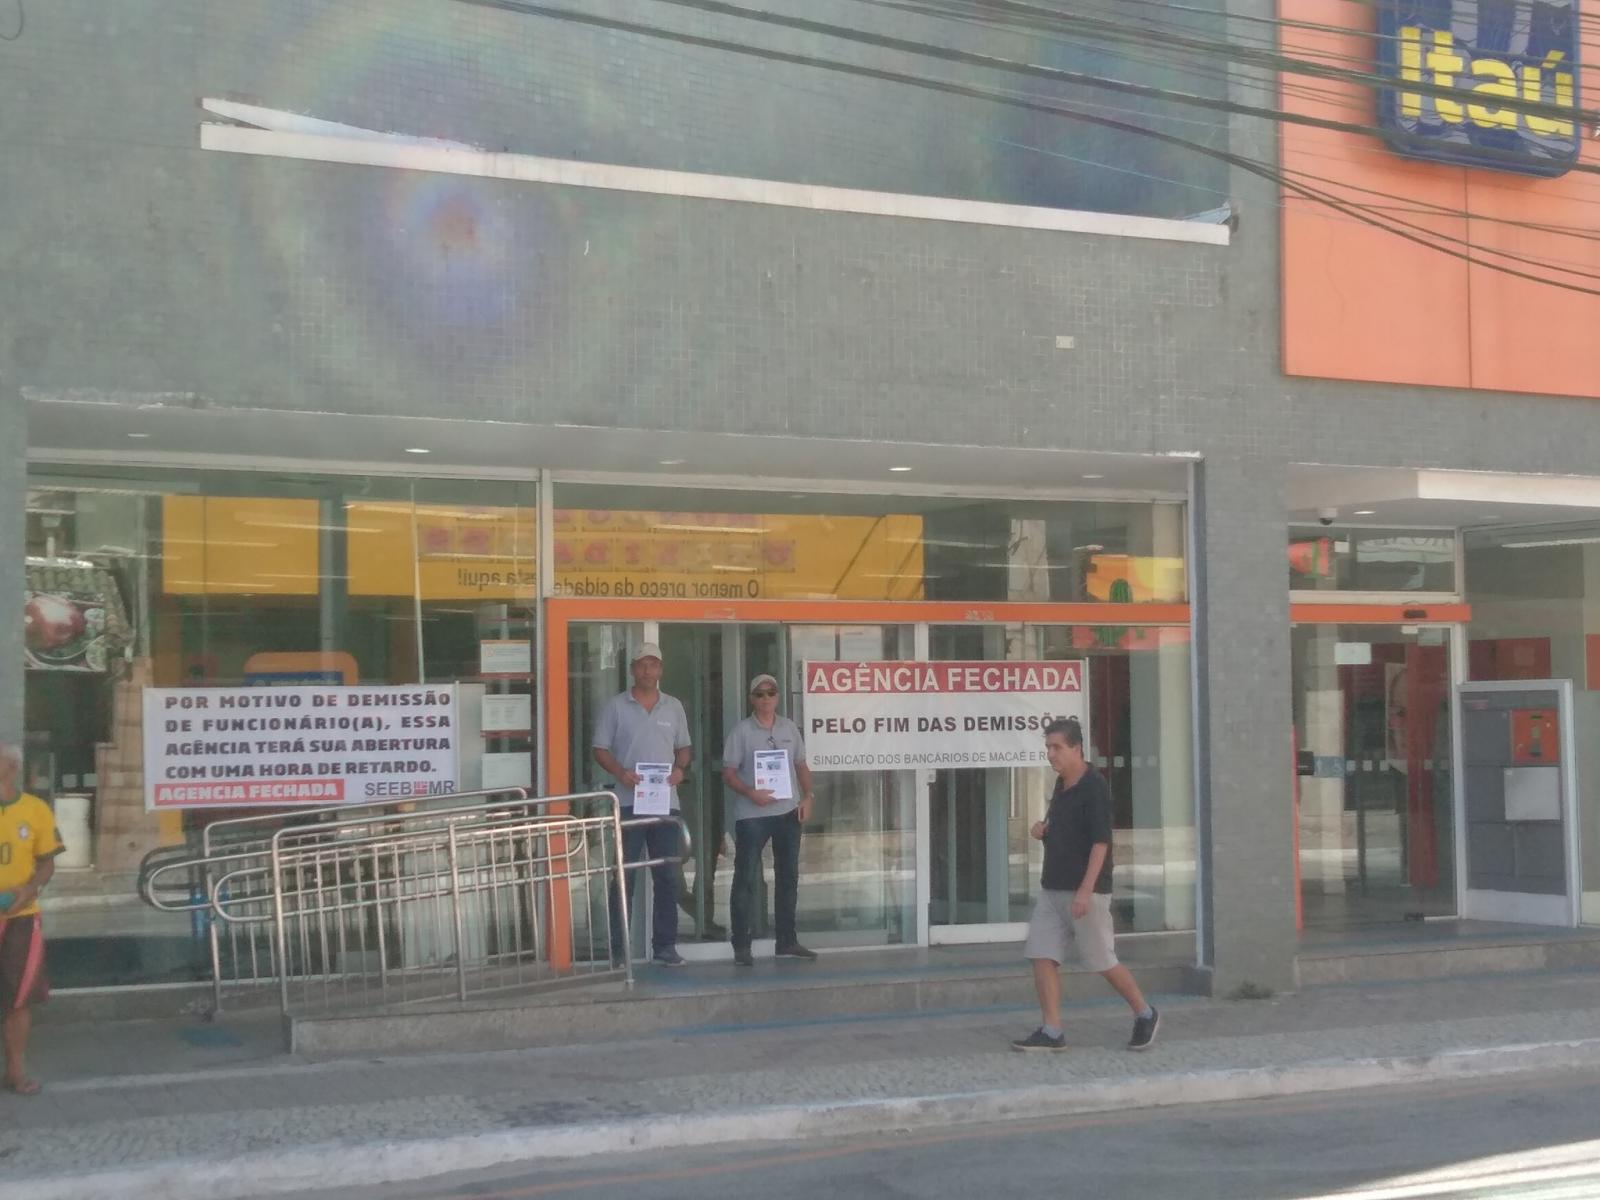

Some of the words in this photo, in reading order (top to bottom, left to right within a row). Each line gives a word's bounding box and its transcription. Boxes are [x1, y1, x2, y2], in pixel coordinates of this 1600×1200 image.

[1401, 26, 1574, 137] Itaú
[810, 662, 940, 692] AGÊNCIA
[947, 667, 1080, 691] FECHADA
[165, 696, 210, 709] POR
[219, 694, 302, 708] MOTIVO
[312, 694, 338, 707] DE
[347, 691, 451, 707] DEMISSÃO
[165, 719, 192, 732] DE
[203, 714, 391, 732] FUNCIONÁRIO(A),
[401, 716, 451, 729] ESSA
[811, 717, 866, 734] PELO
[874, 717, 909, 733] FIM
[917, 716, 957, 732] DAS
[165, 739, 251, 756] AGÊNCIA
[255, 737, 305, 754] TERÁ
[309, 740, 348, 753] SUA
[351, 738, 451, 752] ABERTURA
[813, 753, 875, 766] SINDICATO
[877, 753, 901, 765] DOS
[972, 752, 987, 762] DE
[989, 749, 1028, 762] MACAÉ
[1029, 751, 1036, 761] E
[165, 765, 207, 780] COM
[212, 764, 254, 778] UMA
[259, 762, 316, 776] HORA
[317, 762, 342, 775] DE
[346, 760, 437, 775] RETARDO.
[251, 782, 338, 799] FECHADA
[365, 781, 412, 797] SEEB
[428, 780, 456, 795] MR
